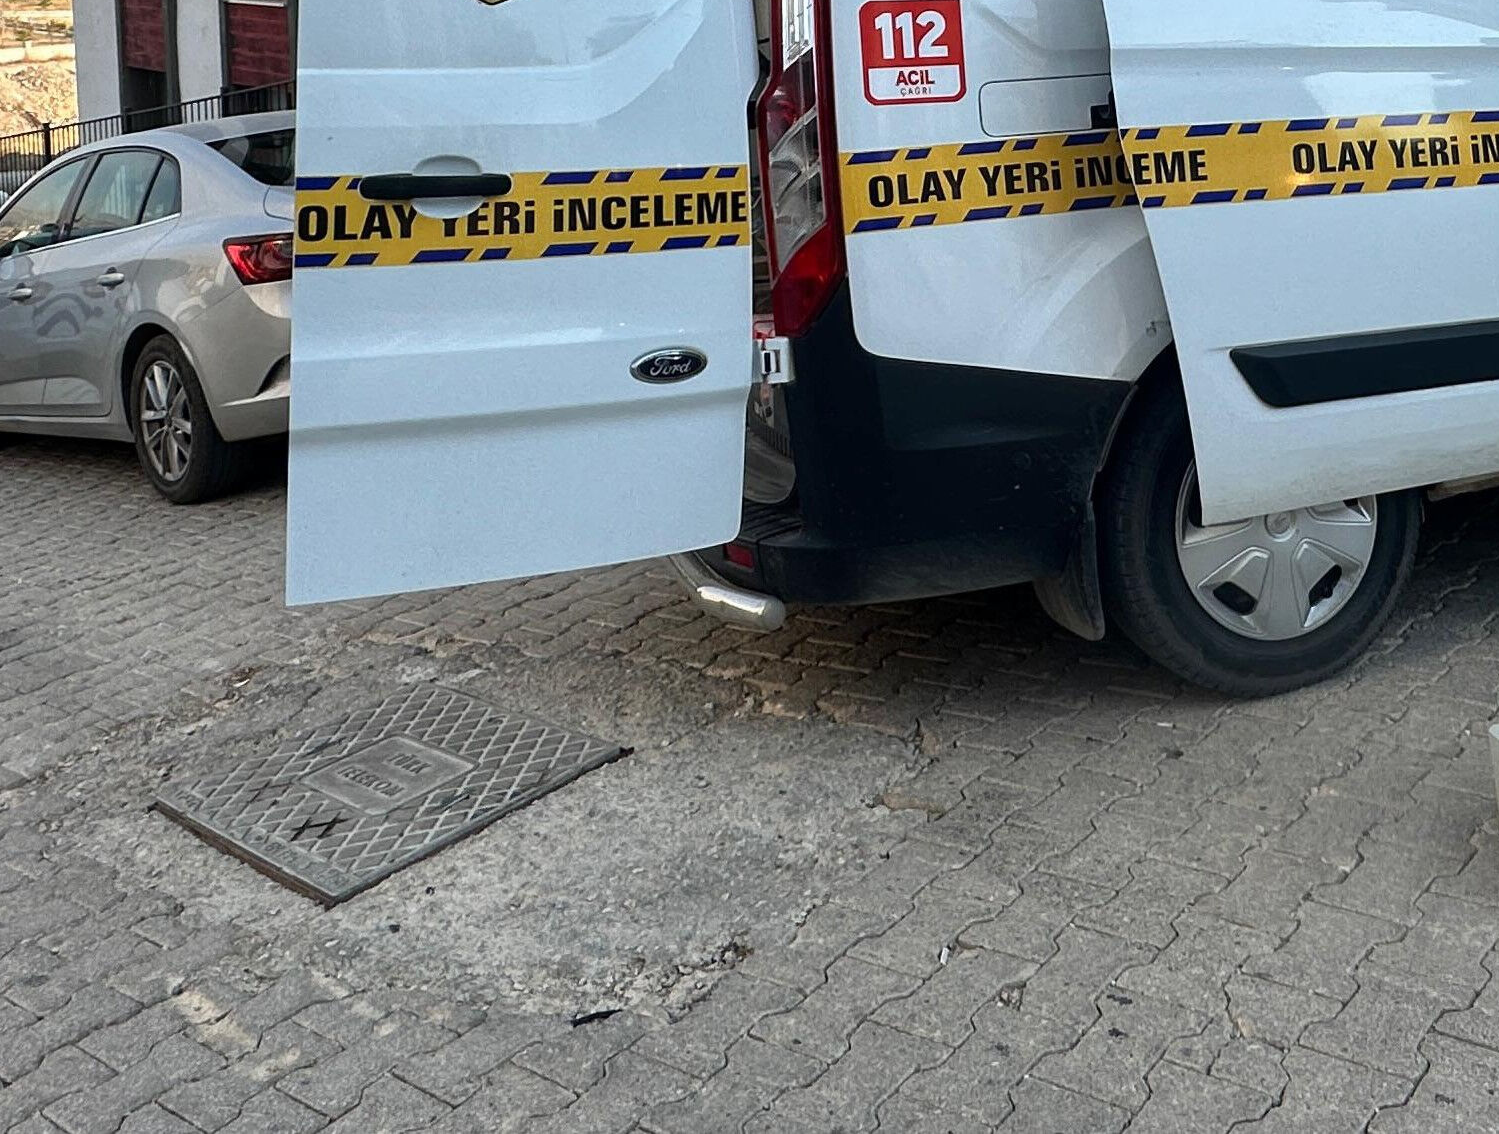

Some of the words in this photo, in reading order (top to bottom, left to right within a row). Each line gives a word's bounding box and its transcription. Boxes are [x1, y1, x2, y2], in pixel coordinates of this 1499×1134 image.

[874, 10, 948, 60] 112
[1292, 141, 1377, 174] OLAY
[868, 169, 966, 208] OLAY
[298, 204, 417, 242] OLAY
[649, 356, 692, 377] Ford
